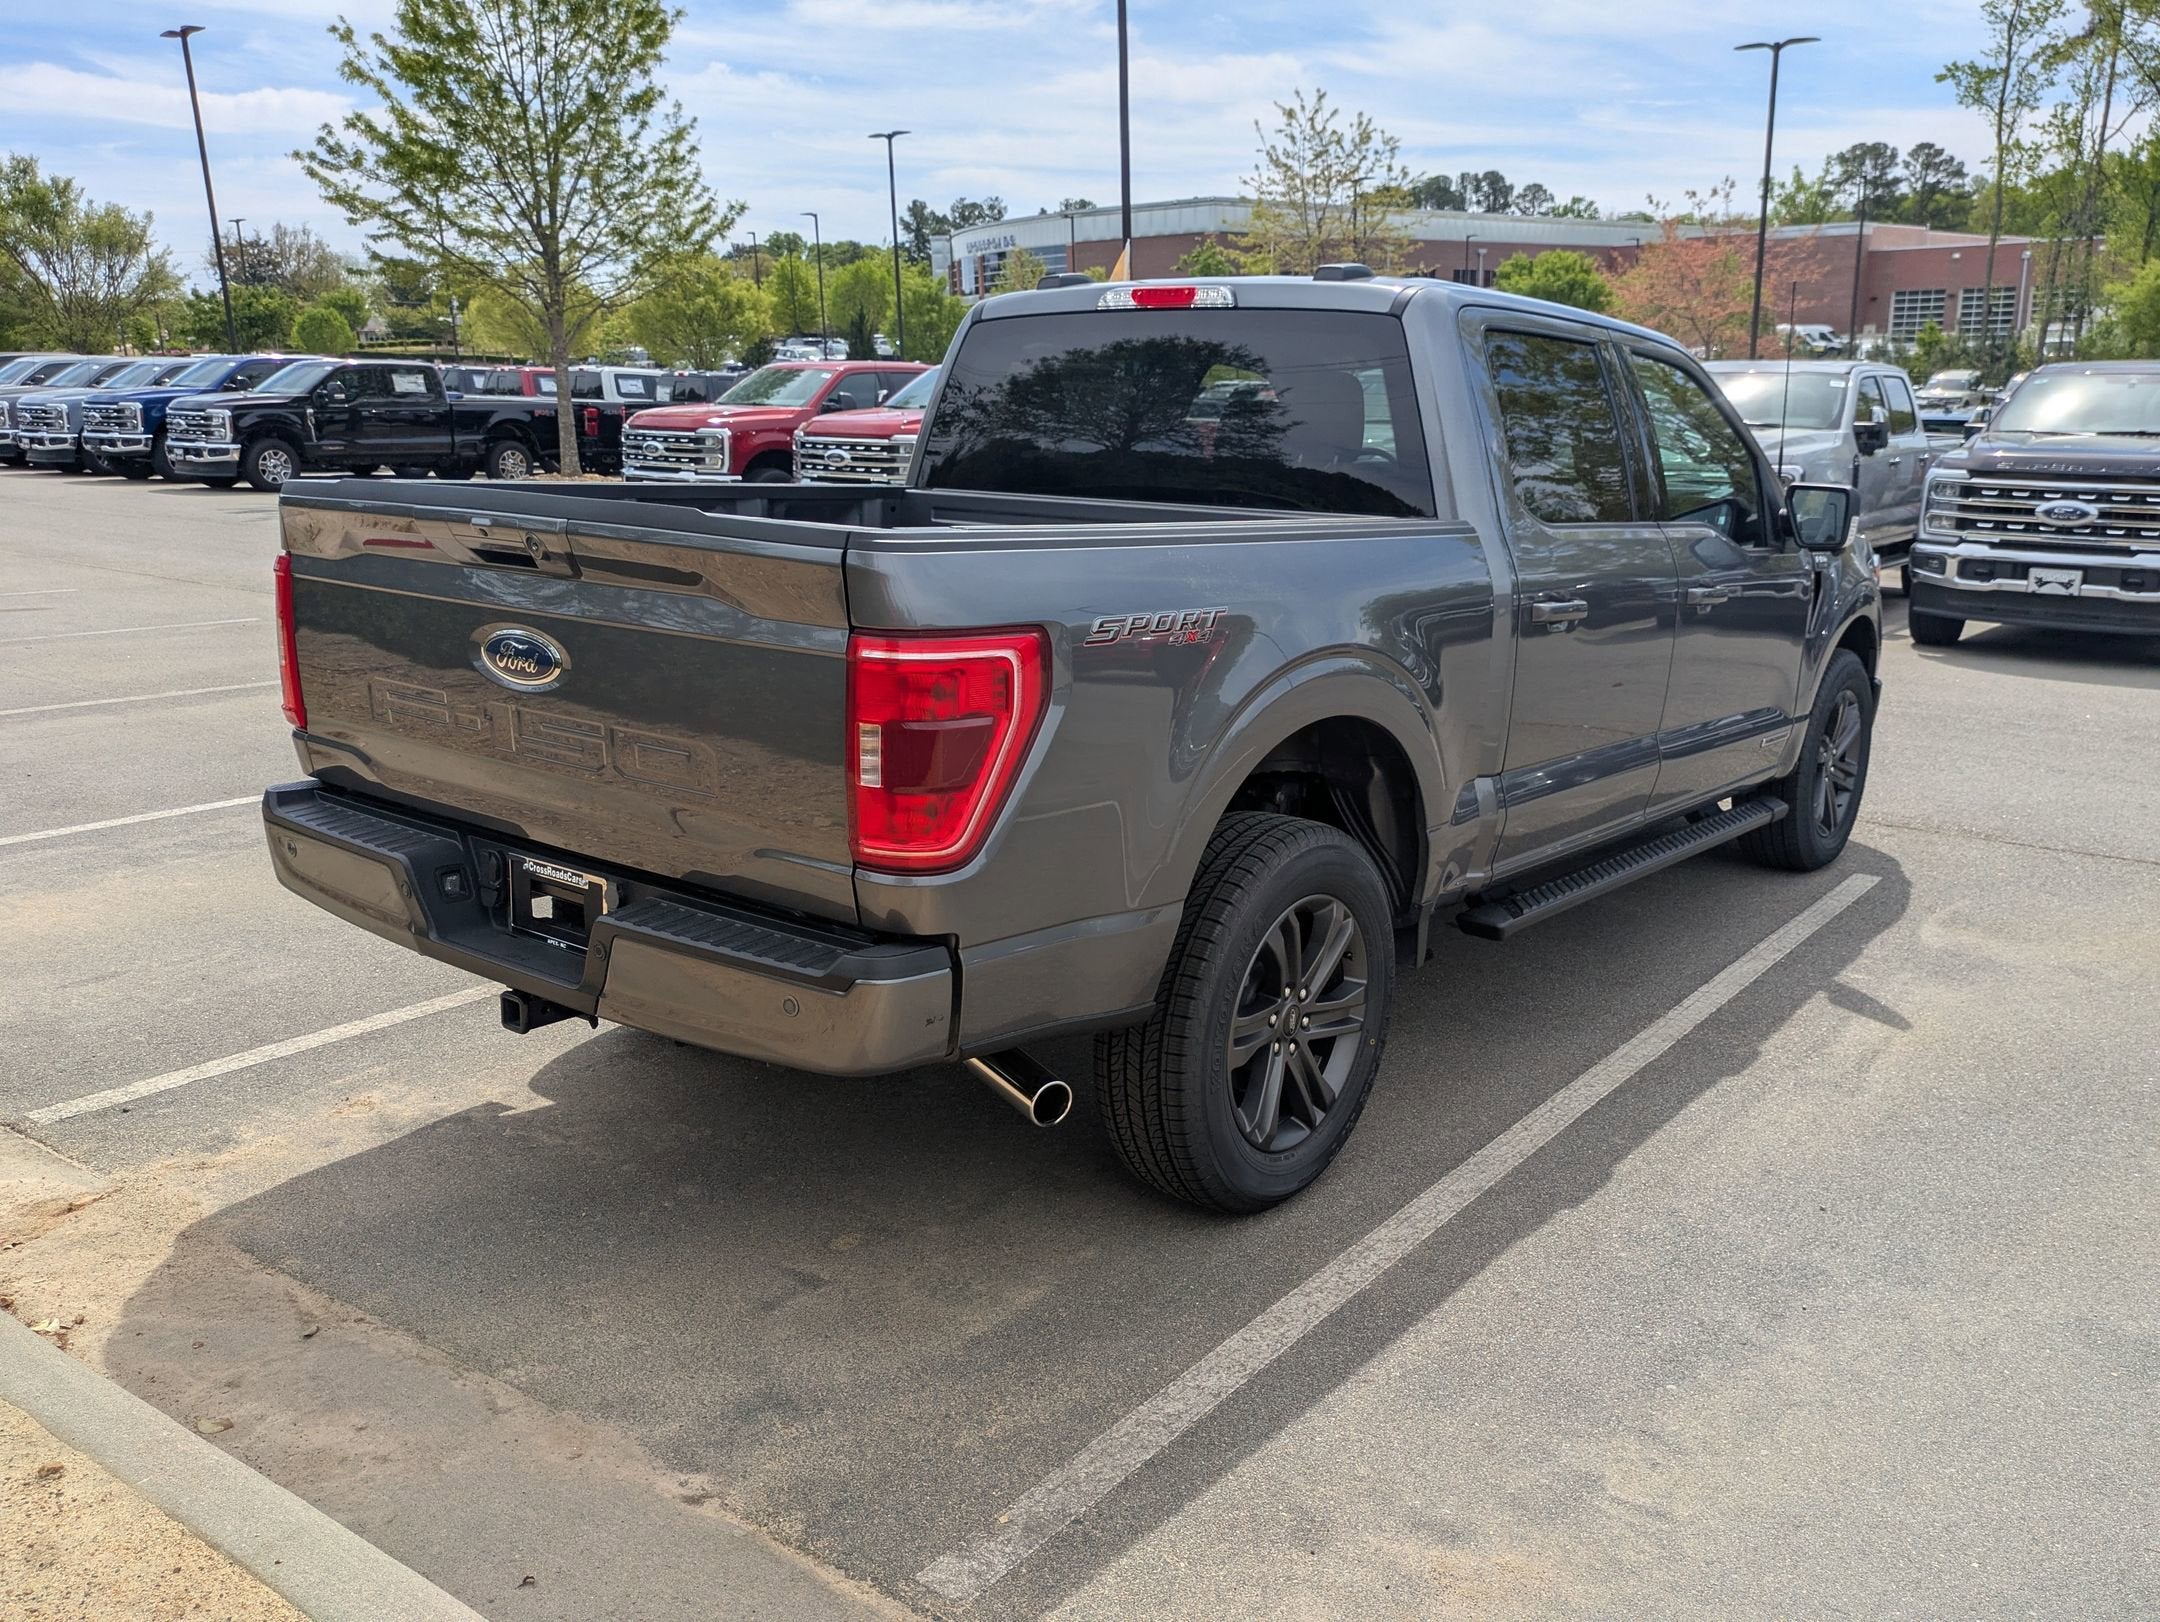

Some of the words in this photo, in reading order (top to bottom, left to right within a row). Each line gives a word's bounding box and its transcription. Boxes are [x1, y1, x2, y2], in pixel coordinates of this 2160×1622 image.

[1083, 606, 1228, 647] SPORT
[496, 641, 538, 673] Ford
[367, 676, 718, 798] F-150
